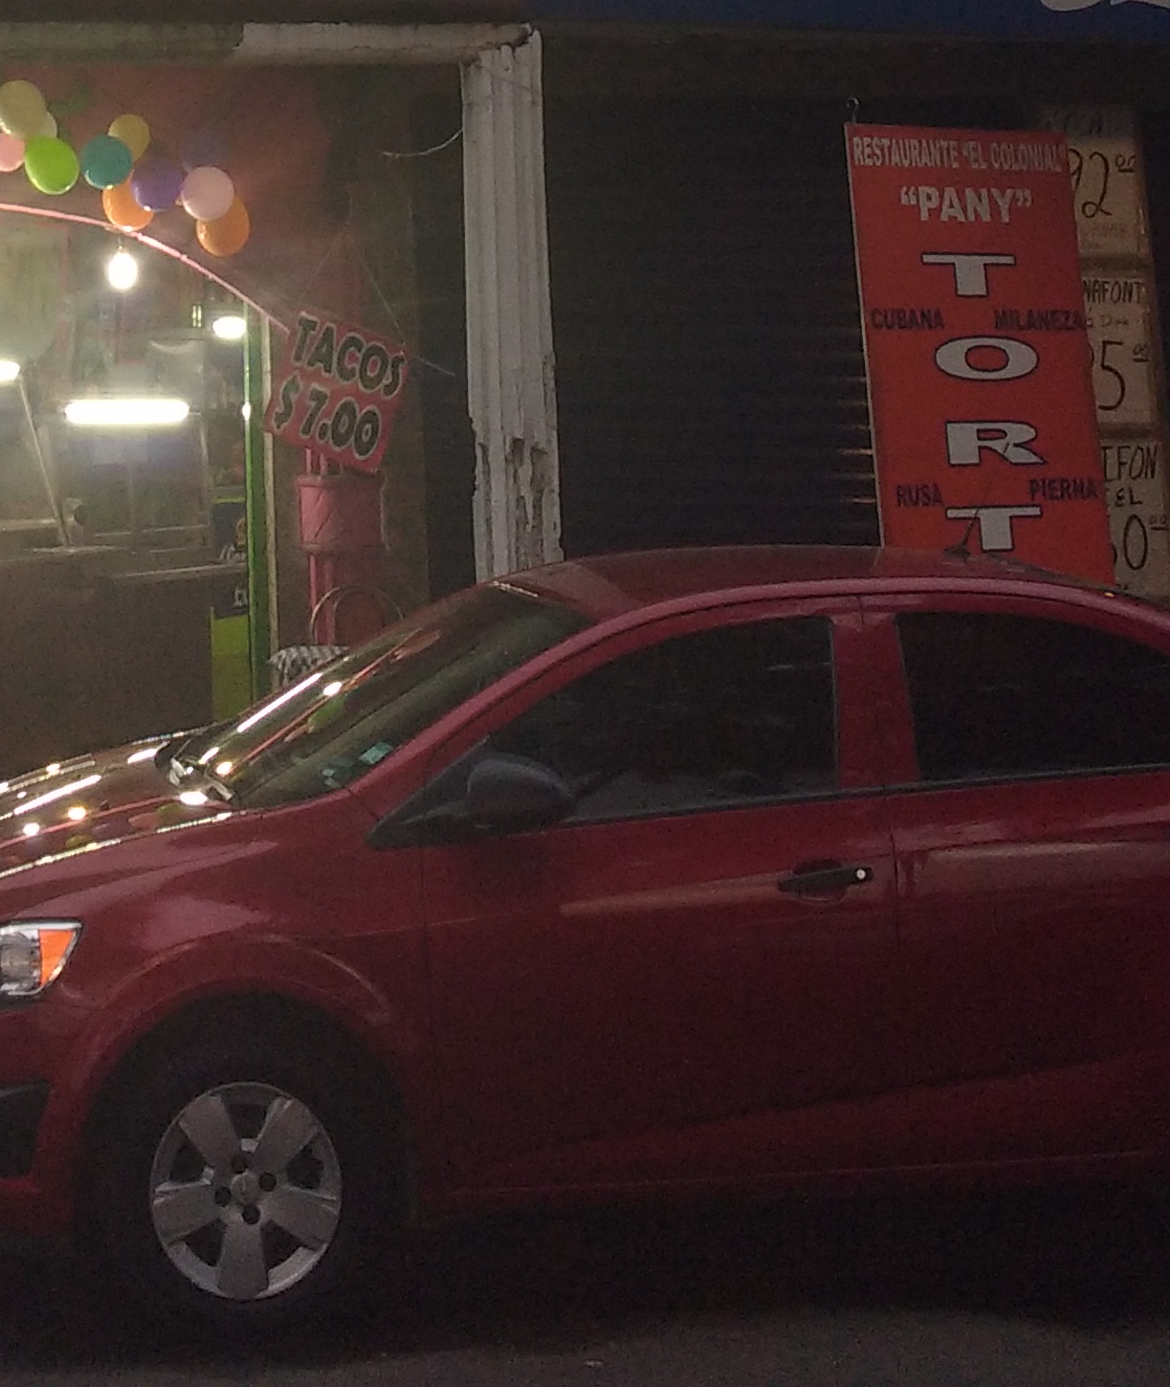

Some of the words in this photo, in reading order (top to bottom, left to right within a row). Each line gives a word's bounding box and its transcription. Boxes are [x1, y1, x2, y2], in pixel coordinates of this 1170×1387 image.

[852, 136, 961, 169] RESTAURANTE
[871, 308, 945, 331] CUBANA
[290, 310, 408, 400] TACOS
[896, 483, 944, 507] RUSA
[1029, 477, 1099, 502] PIERNA
